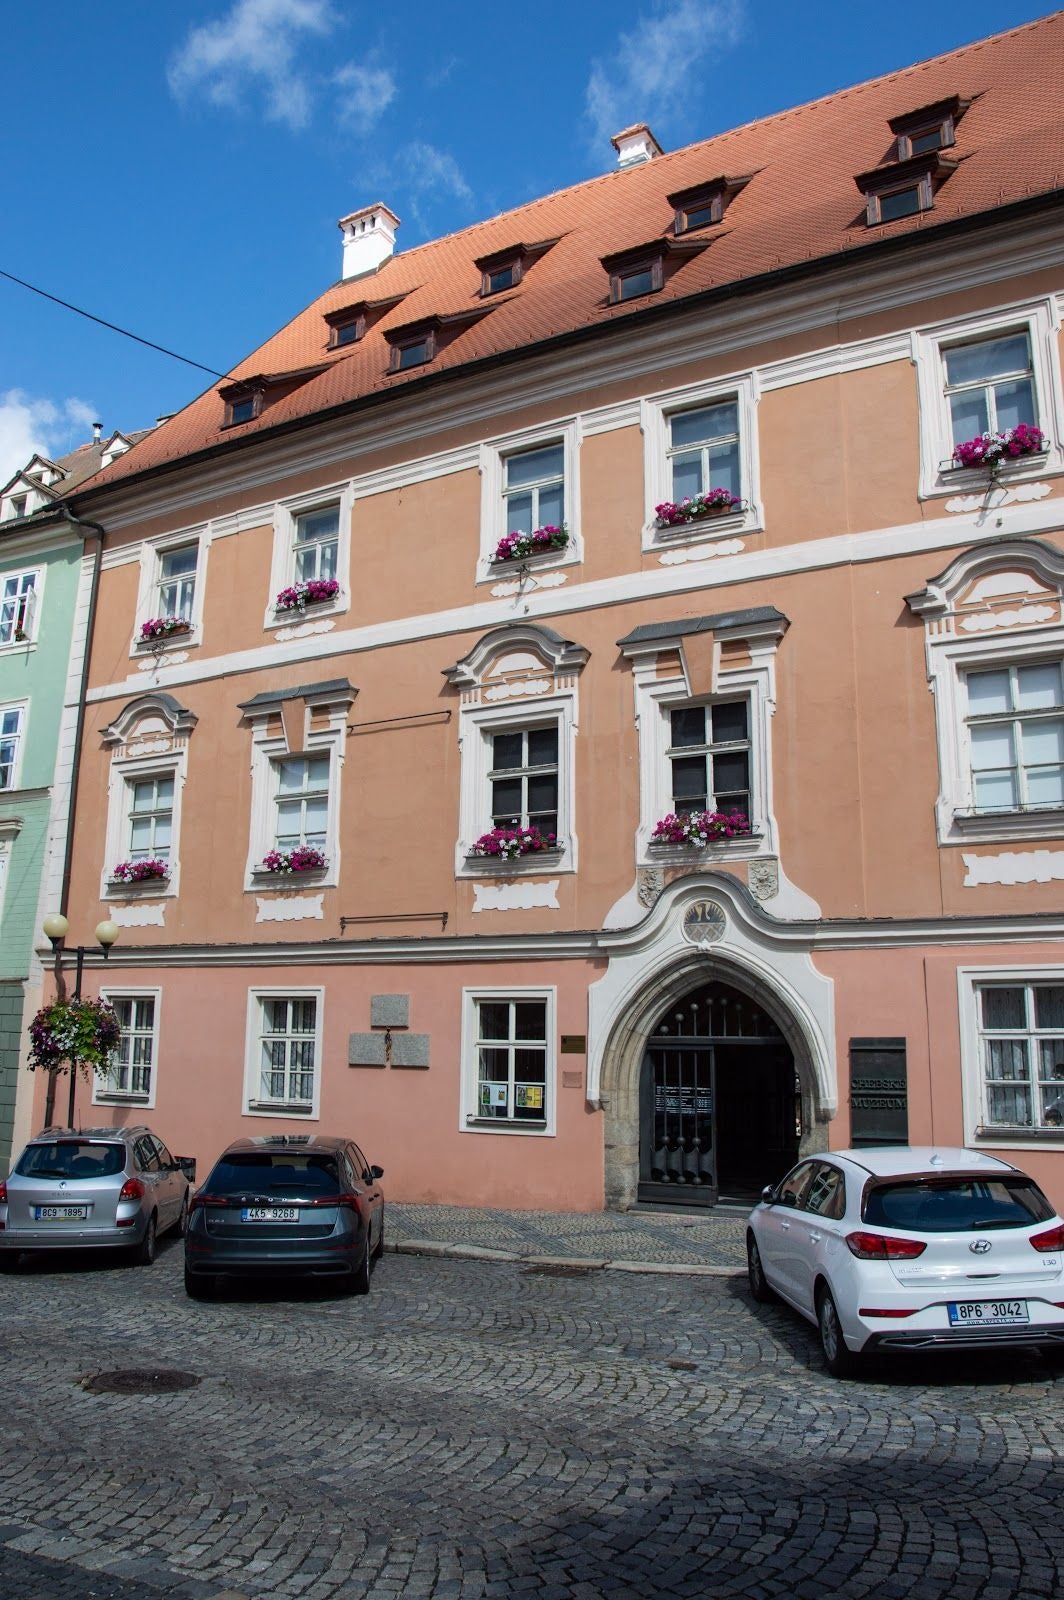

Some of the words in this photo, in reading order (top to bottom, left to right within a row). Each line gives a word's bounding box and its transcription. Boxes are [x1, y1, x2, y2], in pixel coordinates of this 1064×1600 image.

[852, 1097, 906, 1108] MUZEUM
[42, 1208, 57, 1217] 8C9
[63, 1208, 83, 1217] 1895
[249, 1208, 266, 1218] 4K5
[272, 1208, 295, 1218] 9268
[959, 1304, 983, 1318] 8P6
[991, 1302, 1023, 1316] 3042
